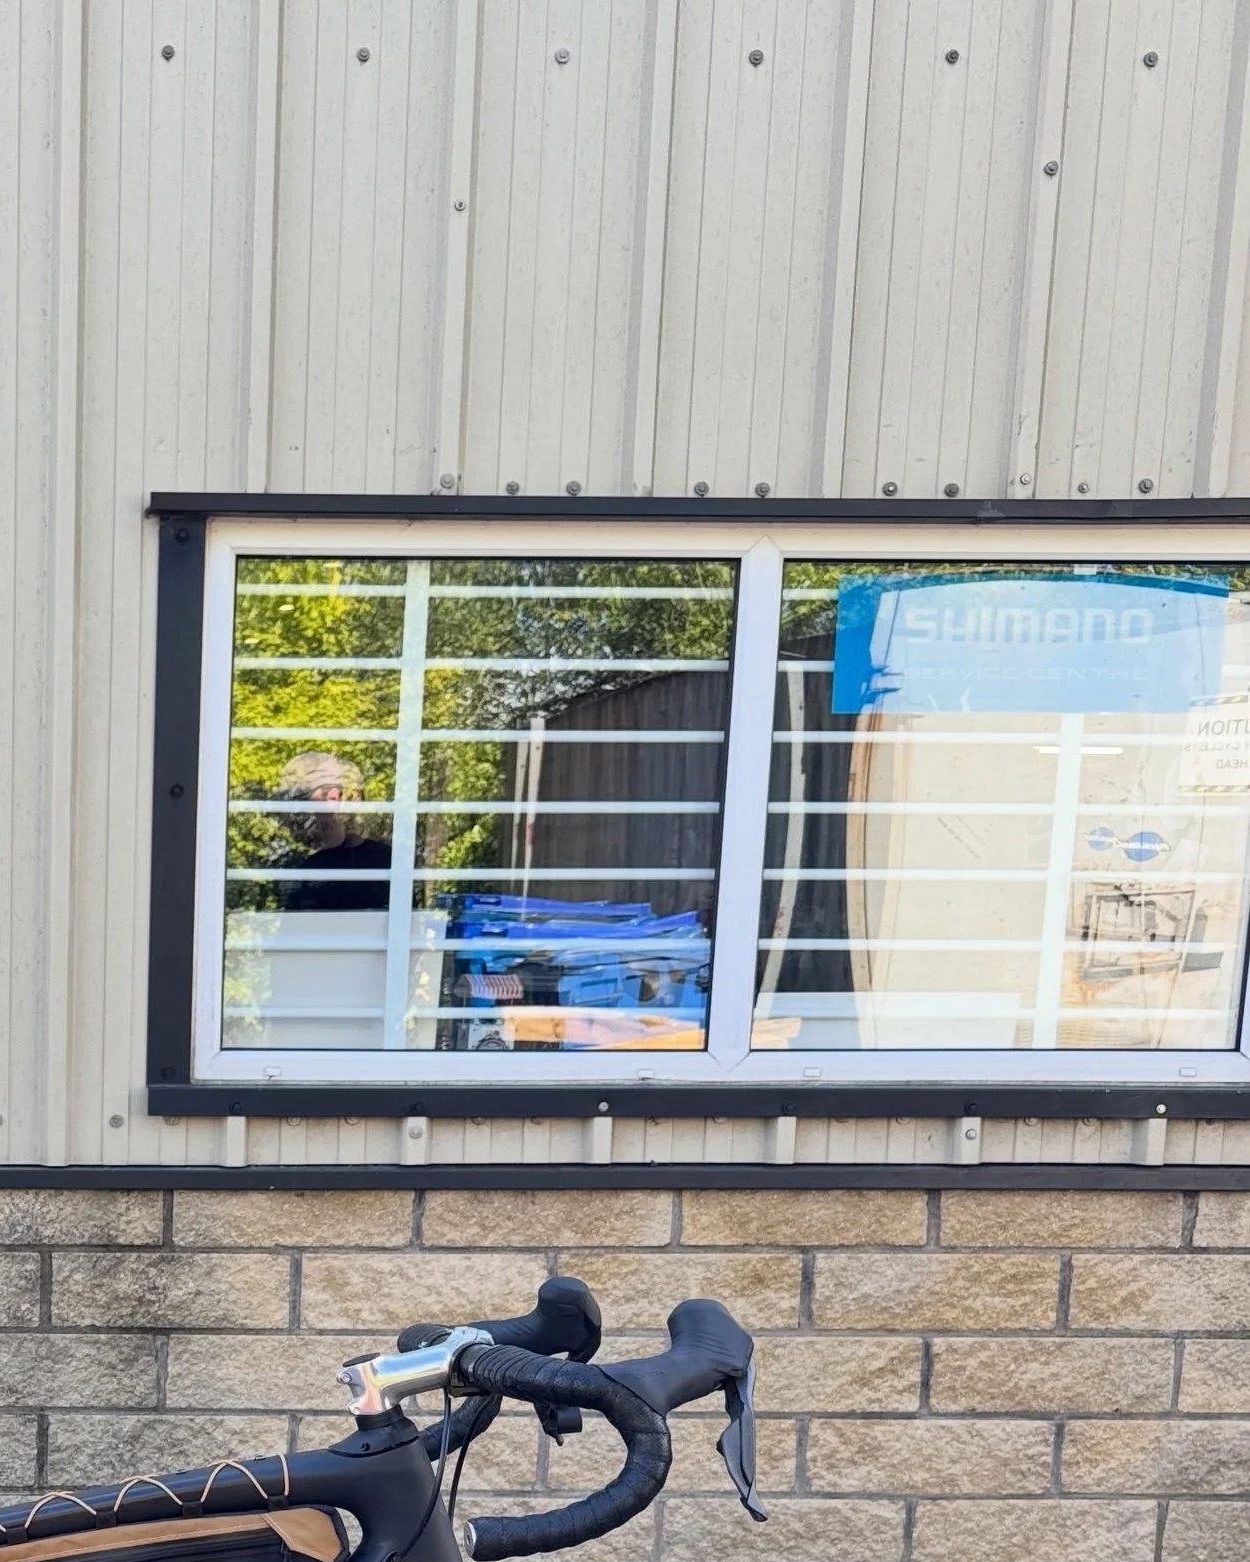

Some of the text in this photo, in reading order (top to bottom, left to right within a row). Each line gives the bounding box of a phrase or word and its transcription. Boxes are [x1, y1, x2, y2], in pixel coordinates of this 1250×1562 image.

[904, 608, 1154, 643] SHIMANO
[904, 667, 1148, 680] SERVICE CENTRE
